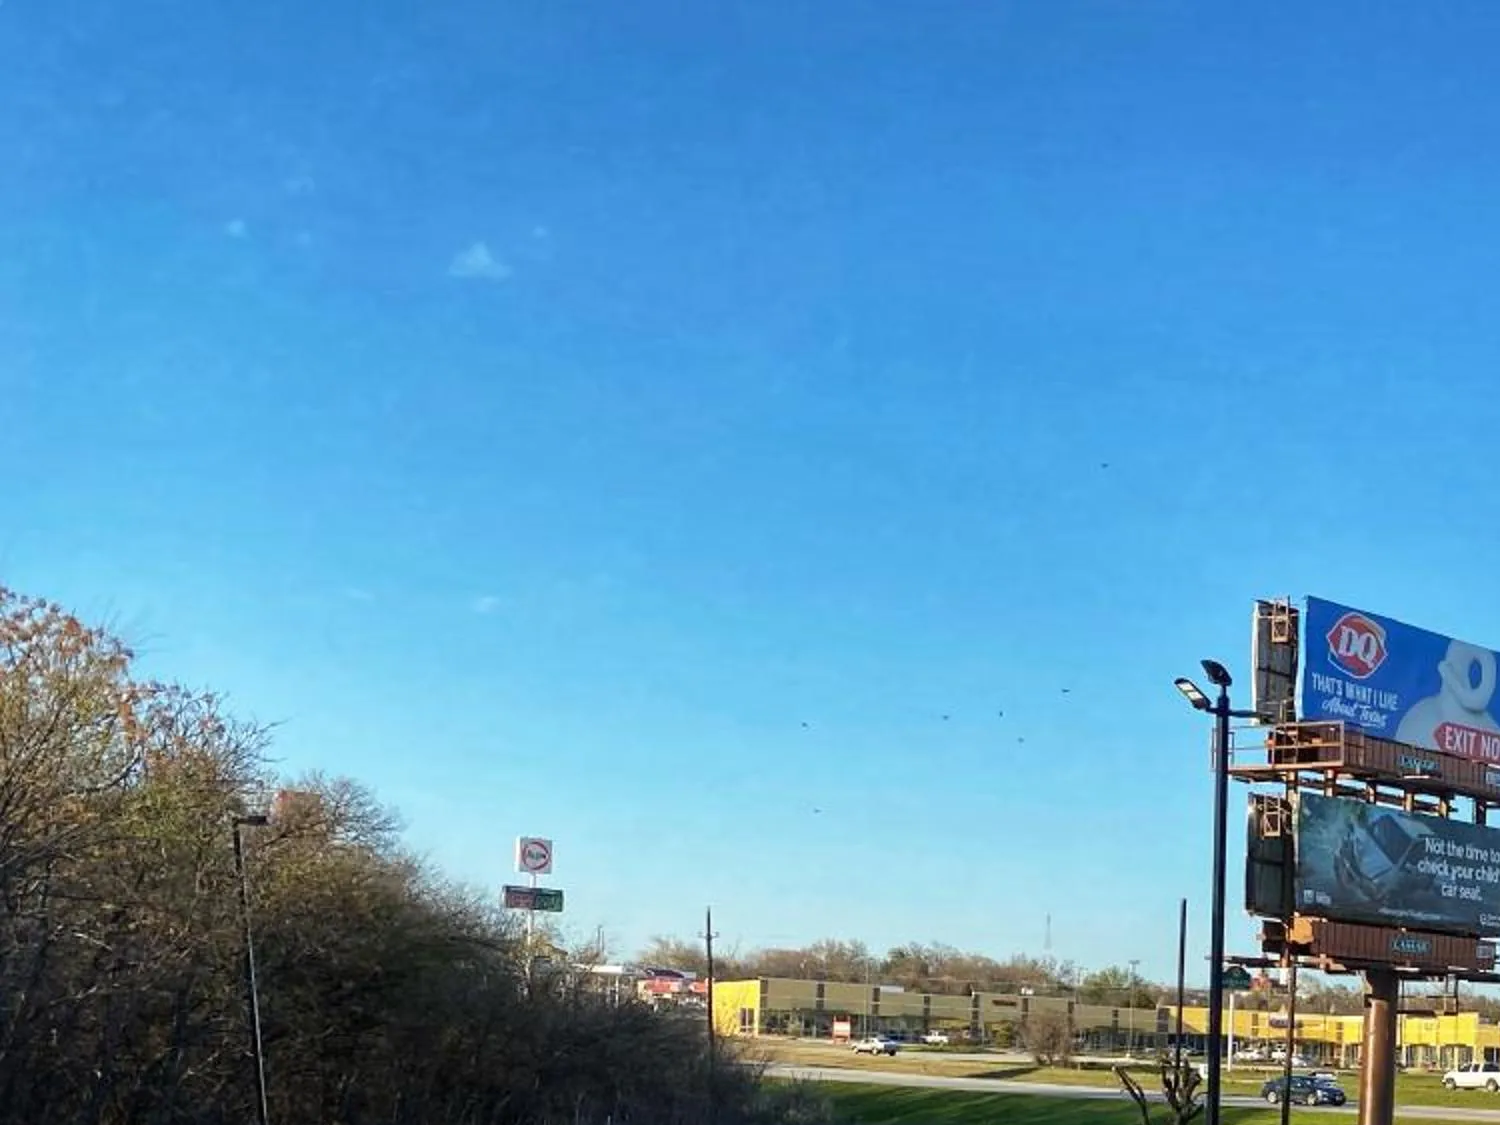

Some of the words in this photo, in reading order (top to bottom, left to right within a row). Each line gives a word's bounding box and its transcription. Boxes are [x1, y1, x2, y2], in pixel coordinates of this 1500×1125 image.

[1338, 625, 1378, 669] DQ
[1445, 725, 1477, 755] EXIT
[1425, 837, 1445, 855] Not
[1447, 840, 1464, 857] the
[1466, 844, 1488, 862] time
[1490, 848, 1500, 864] to
[1417, 856, 1449, 876] check
[1450, 866, 1474, 883] your
[1441, 884, 1457, 897] car
